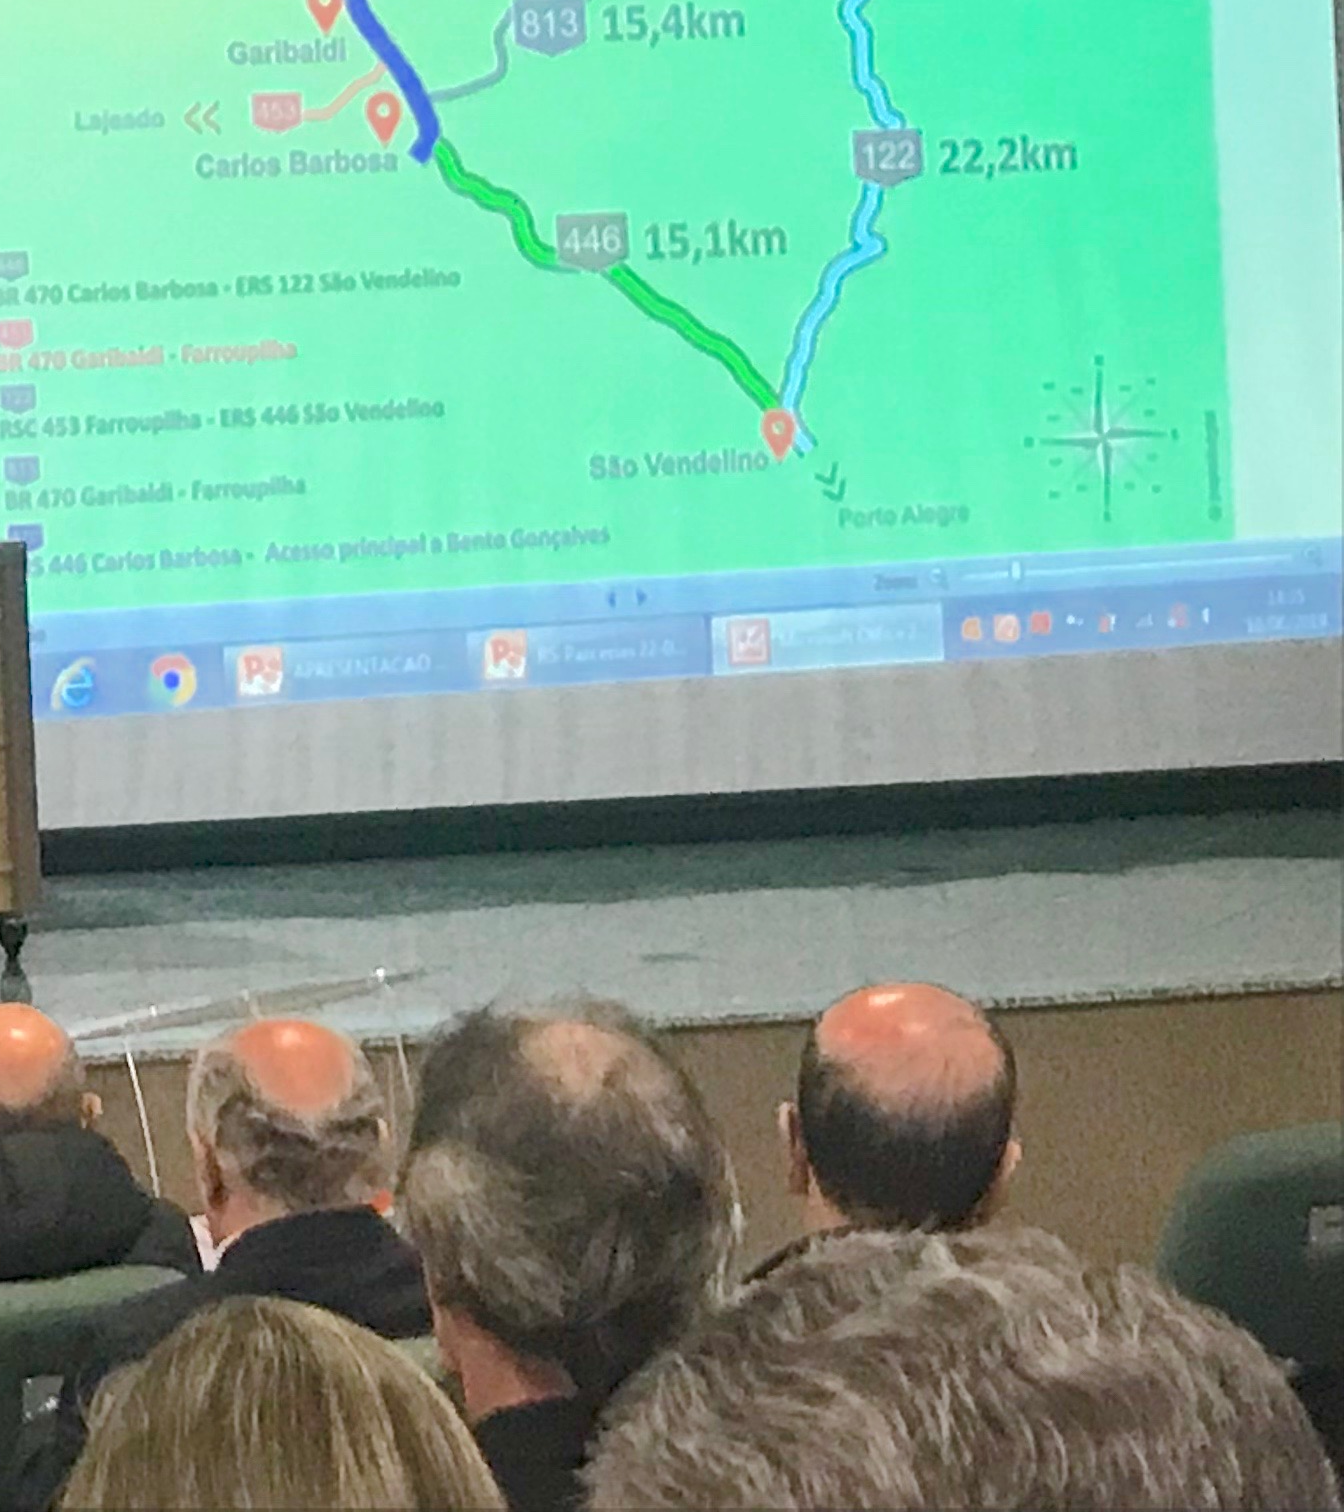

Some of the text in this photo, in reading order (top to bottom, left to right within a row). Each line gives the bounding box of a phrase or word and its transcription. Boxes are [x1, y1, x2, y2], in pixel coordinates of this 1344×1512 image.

[519, 7, 579, 39] 813
[602, 3, 746, 48] 15,4km
[227, 36, 347, 66] Garibaldi
[195, 149, 399, 178] Carlos Barbosa
[862, 140, 916, 172] 122
[937, 134, 1079, 180] 22,2km
[562, 224, 622, 254] 446
[643, 218, 789, 264] 15,1km
[588, 449, 770, 480] São Vendelino
